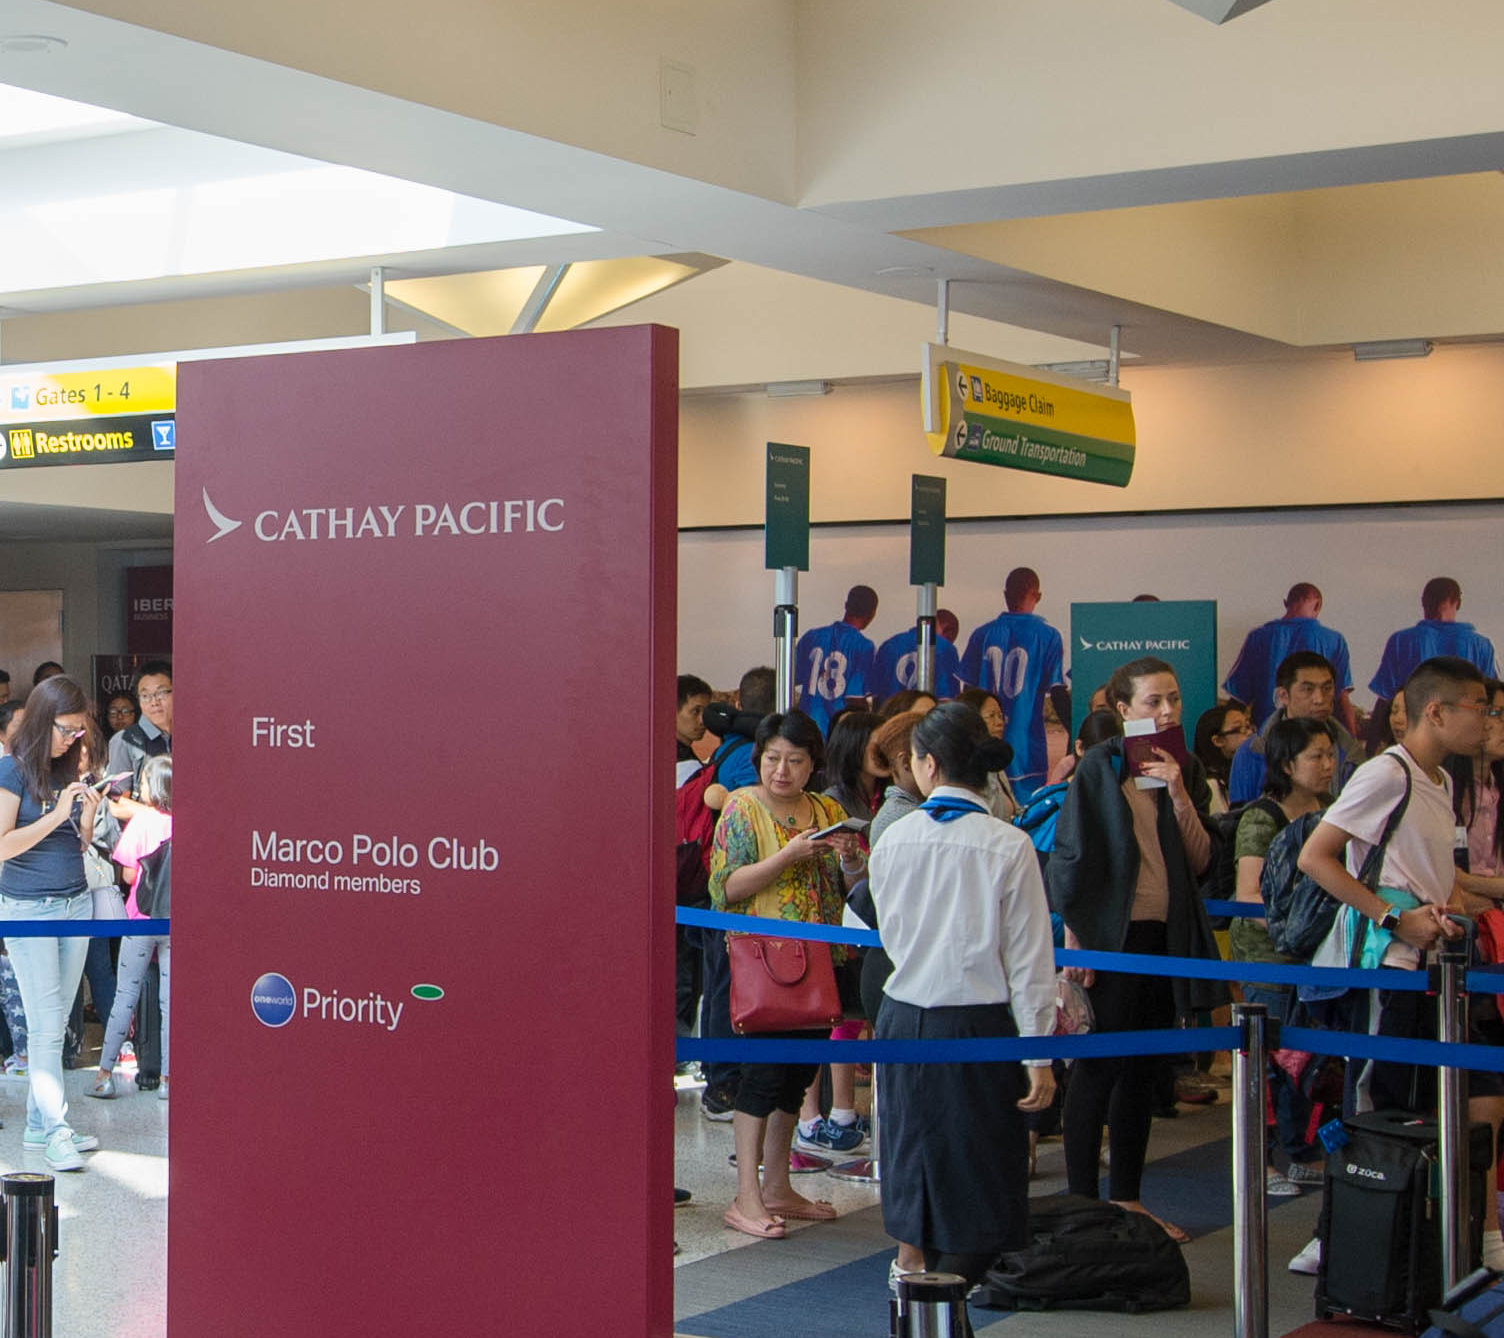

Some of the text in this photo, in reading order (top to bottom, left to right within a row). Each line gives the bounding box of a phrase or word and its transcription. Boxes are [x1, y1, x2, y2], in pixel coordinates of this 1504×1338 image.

[35, 387, 86, 406] Gates
[93, 383, 101, 402] 1
[119, 381, 130, 400] 4
[984, 382, 1055, 417] Baggage Claim
[35, 430, 134, 454] Restrooms
[982, 429, 1088, 467] Ground Transportation
[253, 498, 565, 541] CATHAY PACIFIC
[1096, 639, 1191, 651] CATHAY PACIFIC
[808, 646, 848, 701] 18
[984, 645, 1029, 699] 10
[251, 717, 316, 749] First
[251, 830, 500, 871] Marco Polo Club
[251, 867, 421, 895] Diamond members
[253, 988, 403, 1031] oneworld Priority
